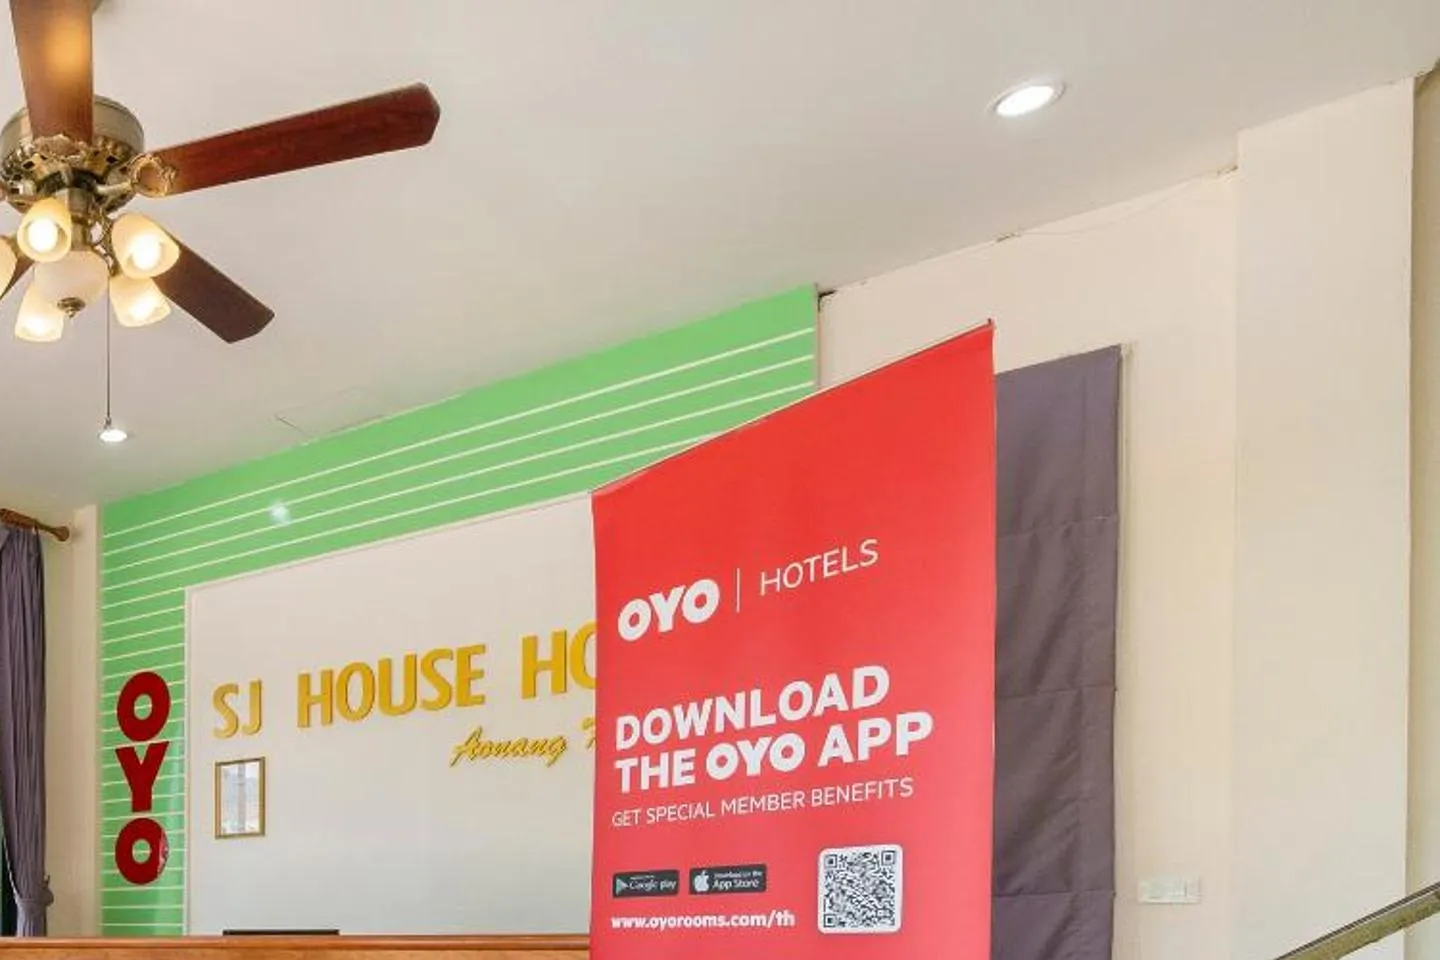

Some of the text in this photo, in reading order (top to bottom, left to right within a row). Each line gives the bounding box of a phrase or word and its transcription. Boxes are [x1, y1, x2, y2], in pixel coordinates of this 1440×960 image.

[617, 538, 880, 642] OYO HOTELS
[213, 678, 264, 739] SJ
[297, 643, 487, 729] HOUSE
[615, 664, 891, 751] DOWNLOAD
[115, 670, 172, 885] OYO
[614, 711, 934, 794] THE OYO APP
[611, 777, 914, 828] GET SPECIAL MEMBER BENEFITS
[611, 910, 796, 931] www.oyorooms.com/th
[712, 878, 760, 891] App Store
